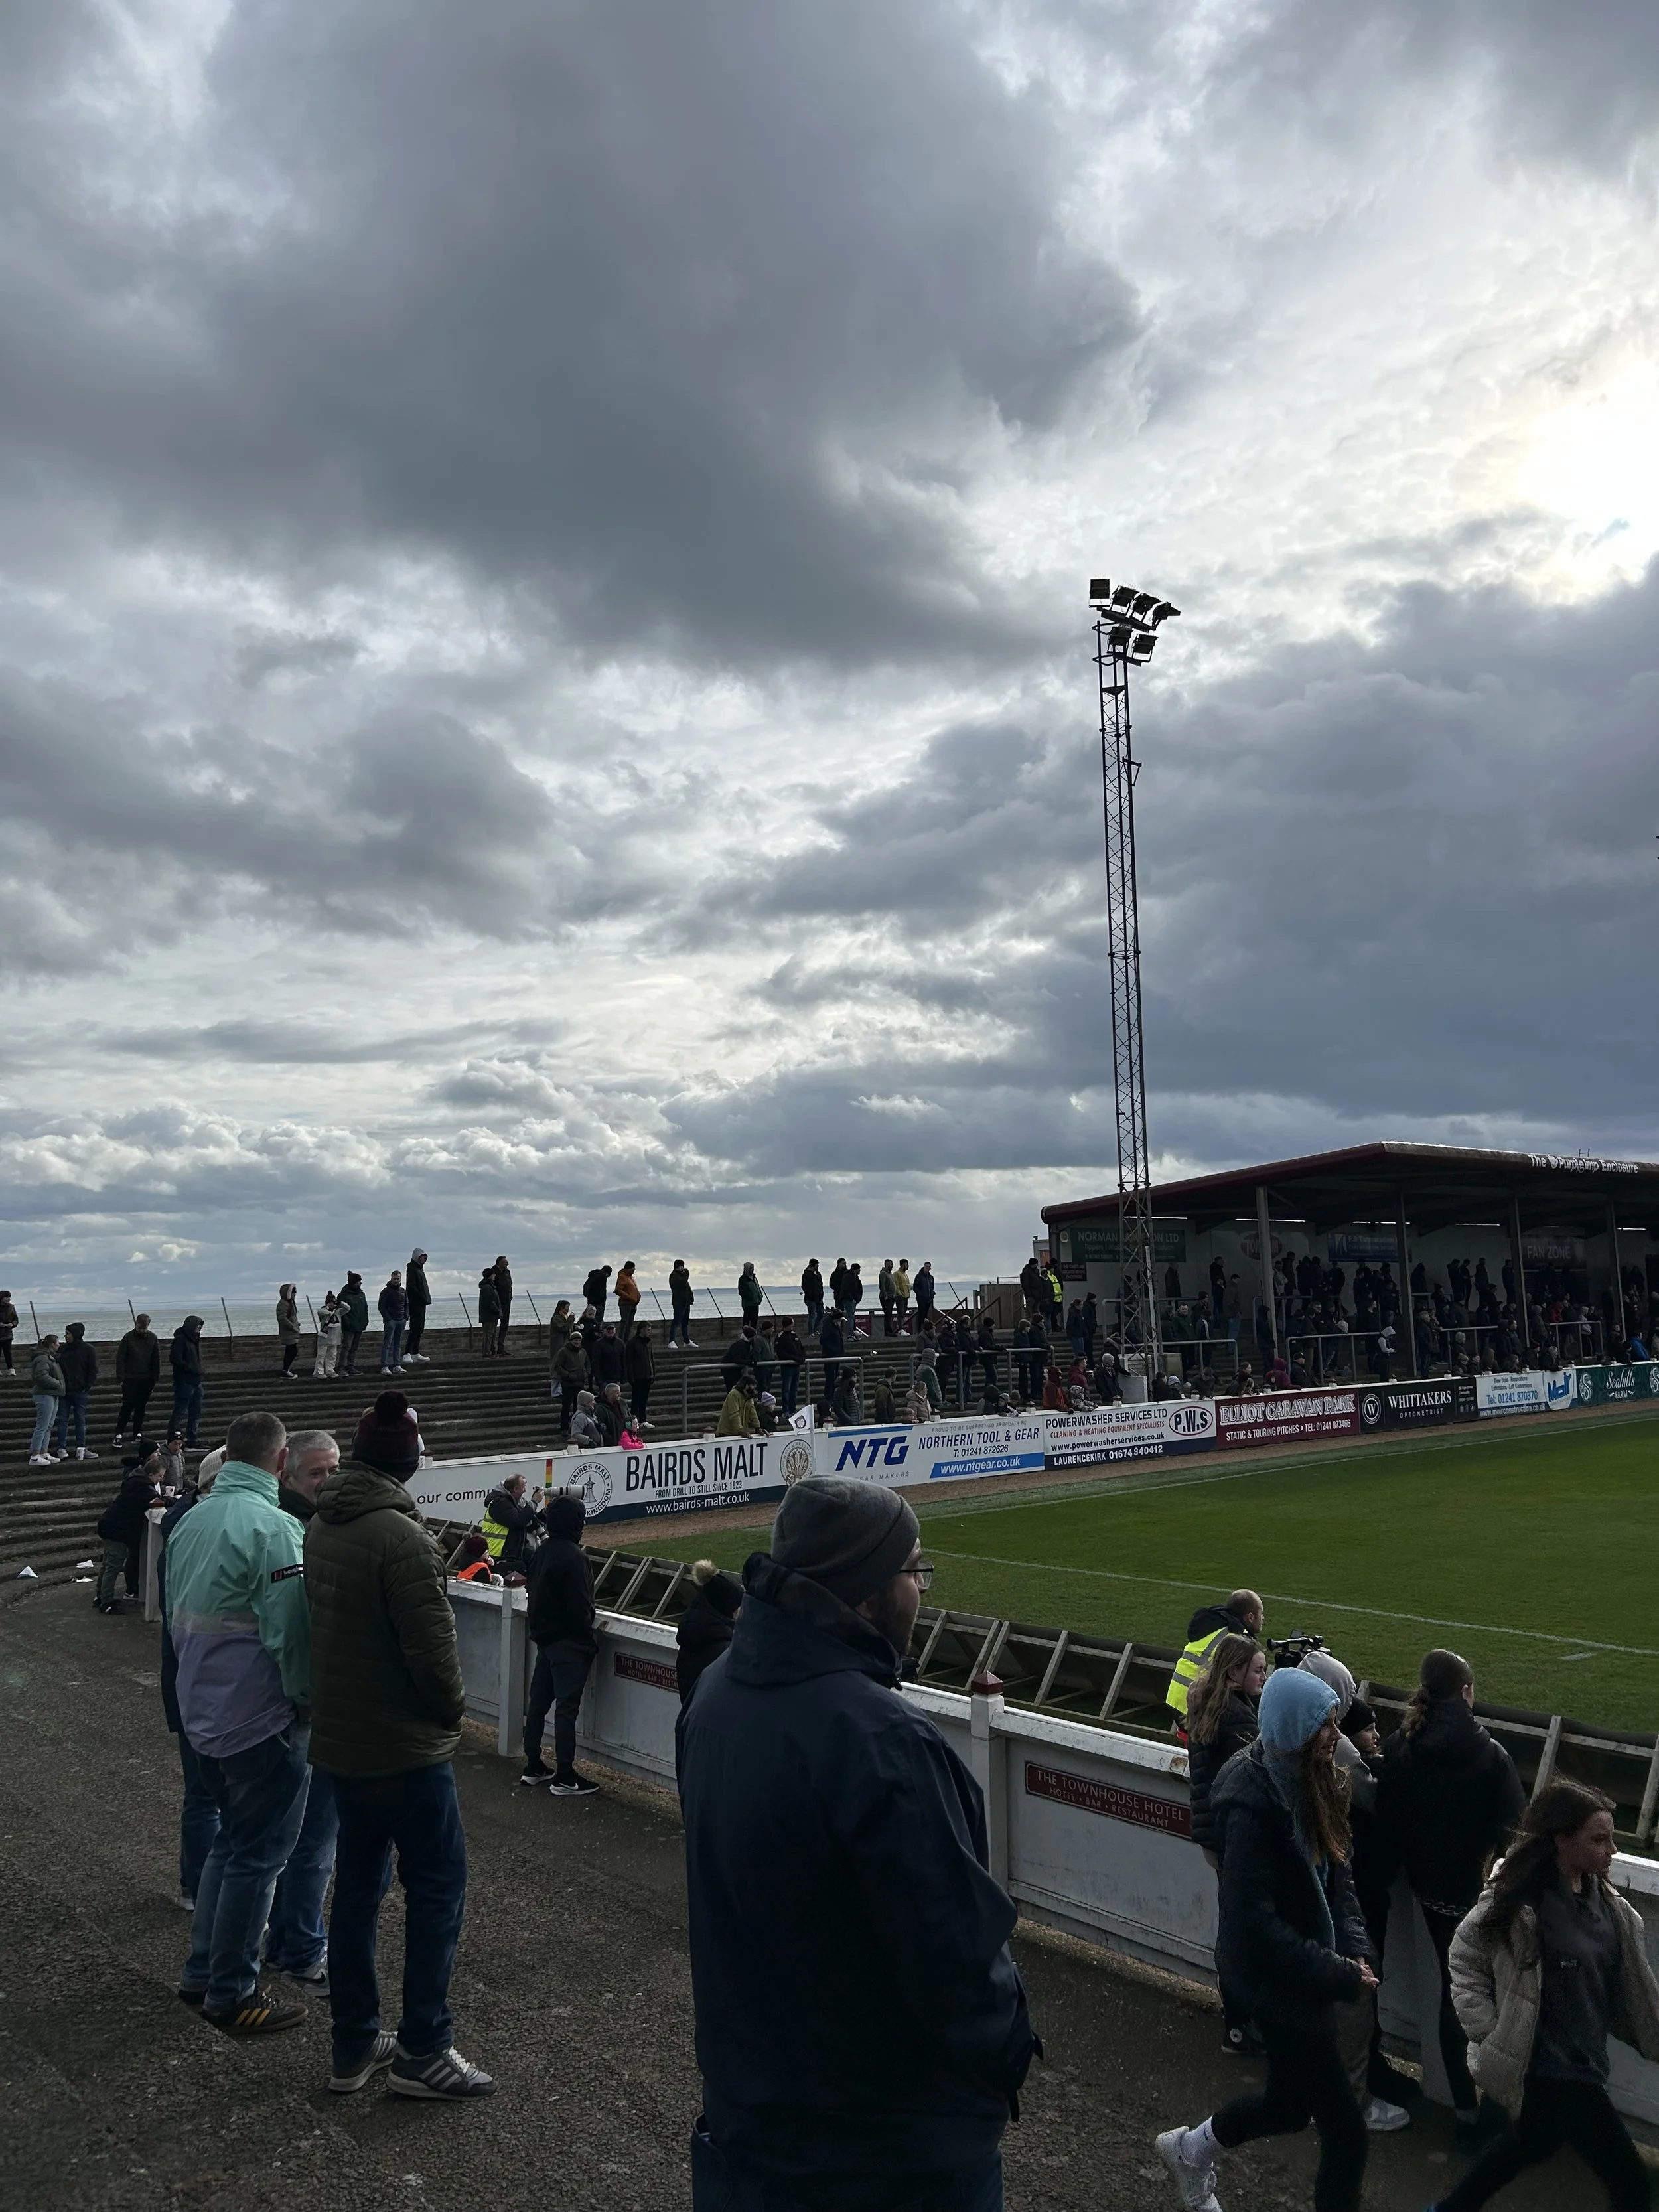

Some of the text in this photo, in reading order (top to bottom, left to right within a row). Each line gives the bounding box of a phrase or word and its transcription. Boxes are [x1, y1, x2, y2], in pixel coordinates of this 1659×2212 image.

[1528, 1155, 1547, 1167] The
[1600, 1159, 1639, 1173] Enclosure
[1078, 1232, 1118, 1242] NORMAN
[1165, 1233, 1180, 1243] LTD
[1527, 1245, 1571, 1260] FAN ZONE
[1607, 1367, 1636, 1389] Seahills
[1388, 1390, 1452, 1409] WHITTAKERS
[1498, 1392, 1515, 1404] 01241
[1517, 1390, 1538, 1402] 870370
[1615, 1390, 1628, 1399] FARM
[1046, 1408, 1167, 1429] POWERWASHER SERVICES LTD
[1220, 1394, 1356, 1426] ELLIOT CARAVAN PARK
[1367, 1403, 1376, 1416] W
[1399, 1408, 1443, 1419] OPTOMETRIST
[918, 1427, 1039, 1449] NORTHERN TOOL & GEAR
[1050, 1430, 1077, 1439] CLEANING
[1084, 1426, 1106, 1435] HEATING
[1108, 1424, 1135, 1433] EQUIPMENT
[1137, 1421, 1165, 1430] SPECIALISTS
[1226, 1419, 1351, 1441] STATIC & TOURING PITCHES TEL: 01241 873466
[954, 1444, 1009, 1458] T: 01241 872626
[1051, 1432, 1165, 1451] www.powerwasherservices.co.uk
[835, 1436, 909, 1471] NTG
[1054, 1445, 1163, 1465] LAURENCEKIRK 01674 840412
[626, 1449, 706, 1491] BAIRDS
[714, 1443, 768, 1481] MALT
[940, 1455, 1021, 1474] www.ntgear.co.uk
[570, 1464, 610, 1485] BAIRDS MALT
[417, 1493, 441, 1504] our
[655, 1481, 742, 1499] FROM DRILL TO STILL SINCE 1823
[587, 1488, 611, 1516] KINGDOM
[646, 1491, 750, 1514] www.bairds-malt.co.uk
[621, 1657, 678, 1680] THE TOWNHOUSE
[662, 1678, 679, 1689] RESTA
[1037, 1770, 1184, 1822] THE TOWNHOUSE HOTEL
[1050, 1787, 1169, 1827] HOTEL BAR RESTAURANT
